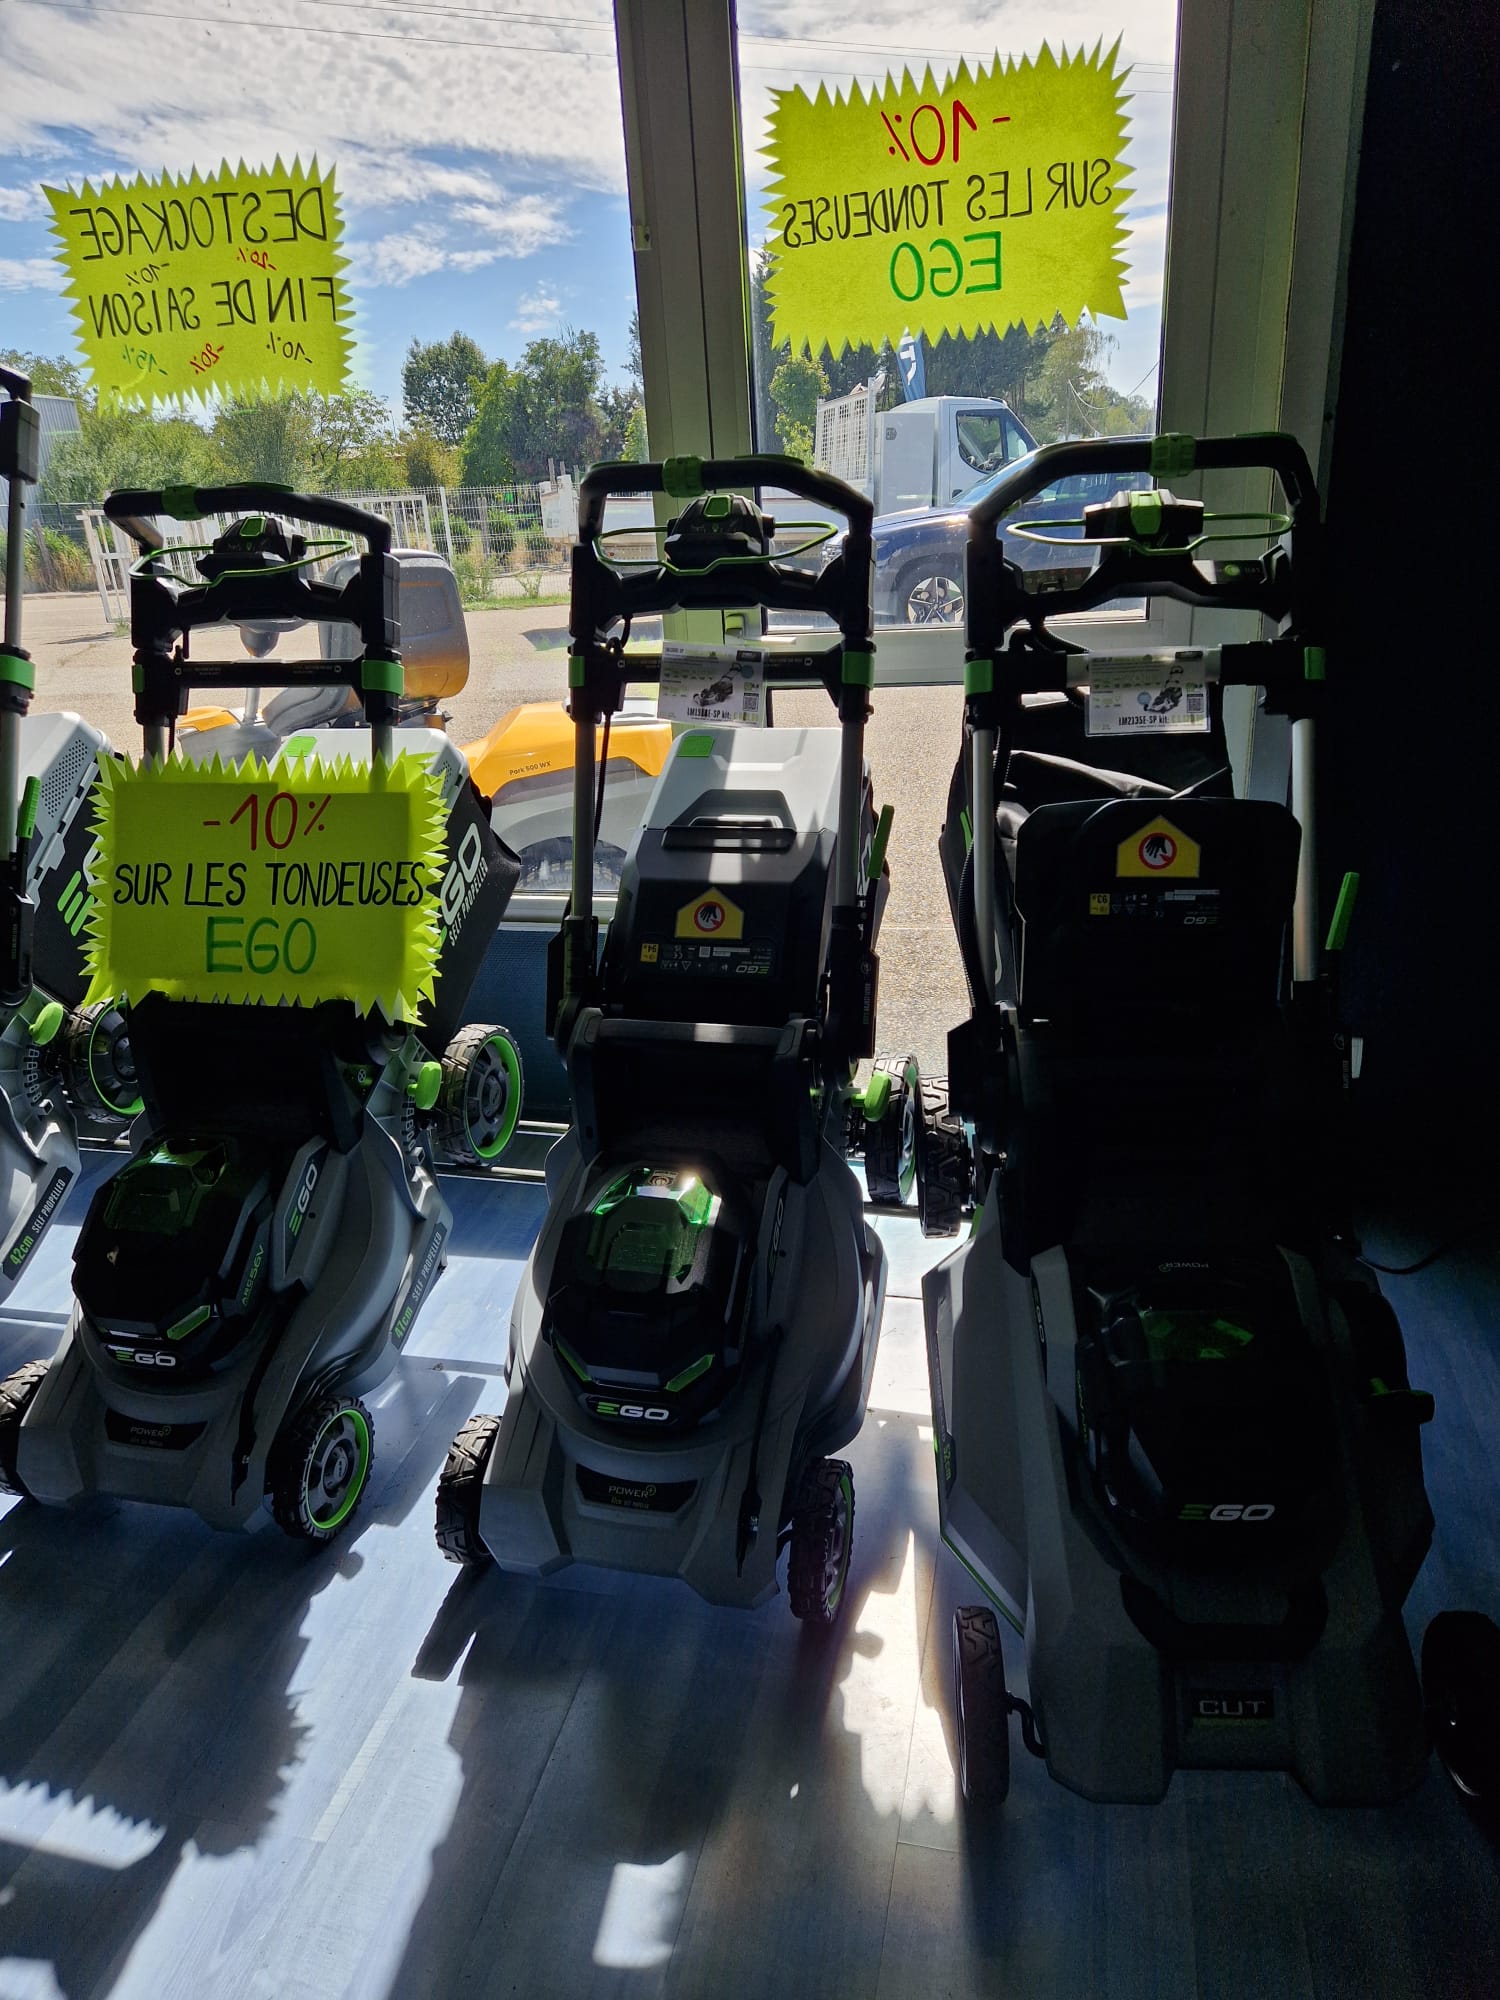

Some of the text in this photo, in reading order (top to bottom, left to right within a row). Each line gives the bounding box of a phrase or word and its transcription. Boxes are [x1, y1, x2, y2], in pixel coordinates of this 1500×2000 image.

[203, 791, 332, 852] -10%
[113, 862, 173, 907] SUR
[183, 862, 248, 907] LES
[264, 860, 427, 907] TONDEUSES
[438, 822, 482, 950] GO
[448, 856, 489, 947] SELF PROPELLED
[205, 915, 318, 976] EGO
[9, 1178, 66, 1265] 42cm SELF PROPELLED
[288, 1163, 318, 1237] EGO
[411, 1278, 425, 1302] SELF
[420, 1231, 442, 1280] PROPELLED
[115, 1350, 177, 1367] EGO
[596, 1401, 670, 1421] EGO
[1176, 1503, 1277, 1521] EGO
[1199, 1699, 1267, 1716] CUT
